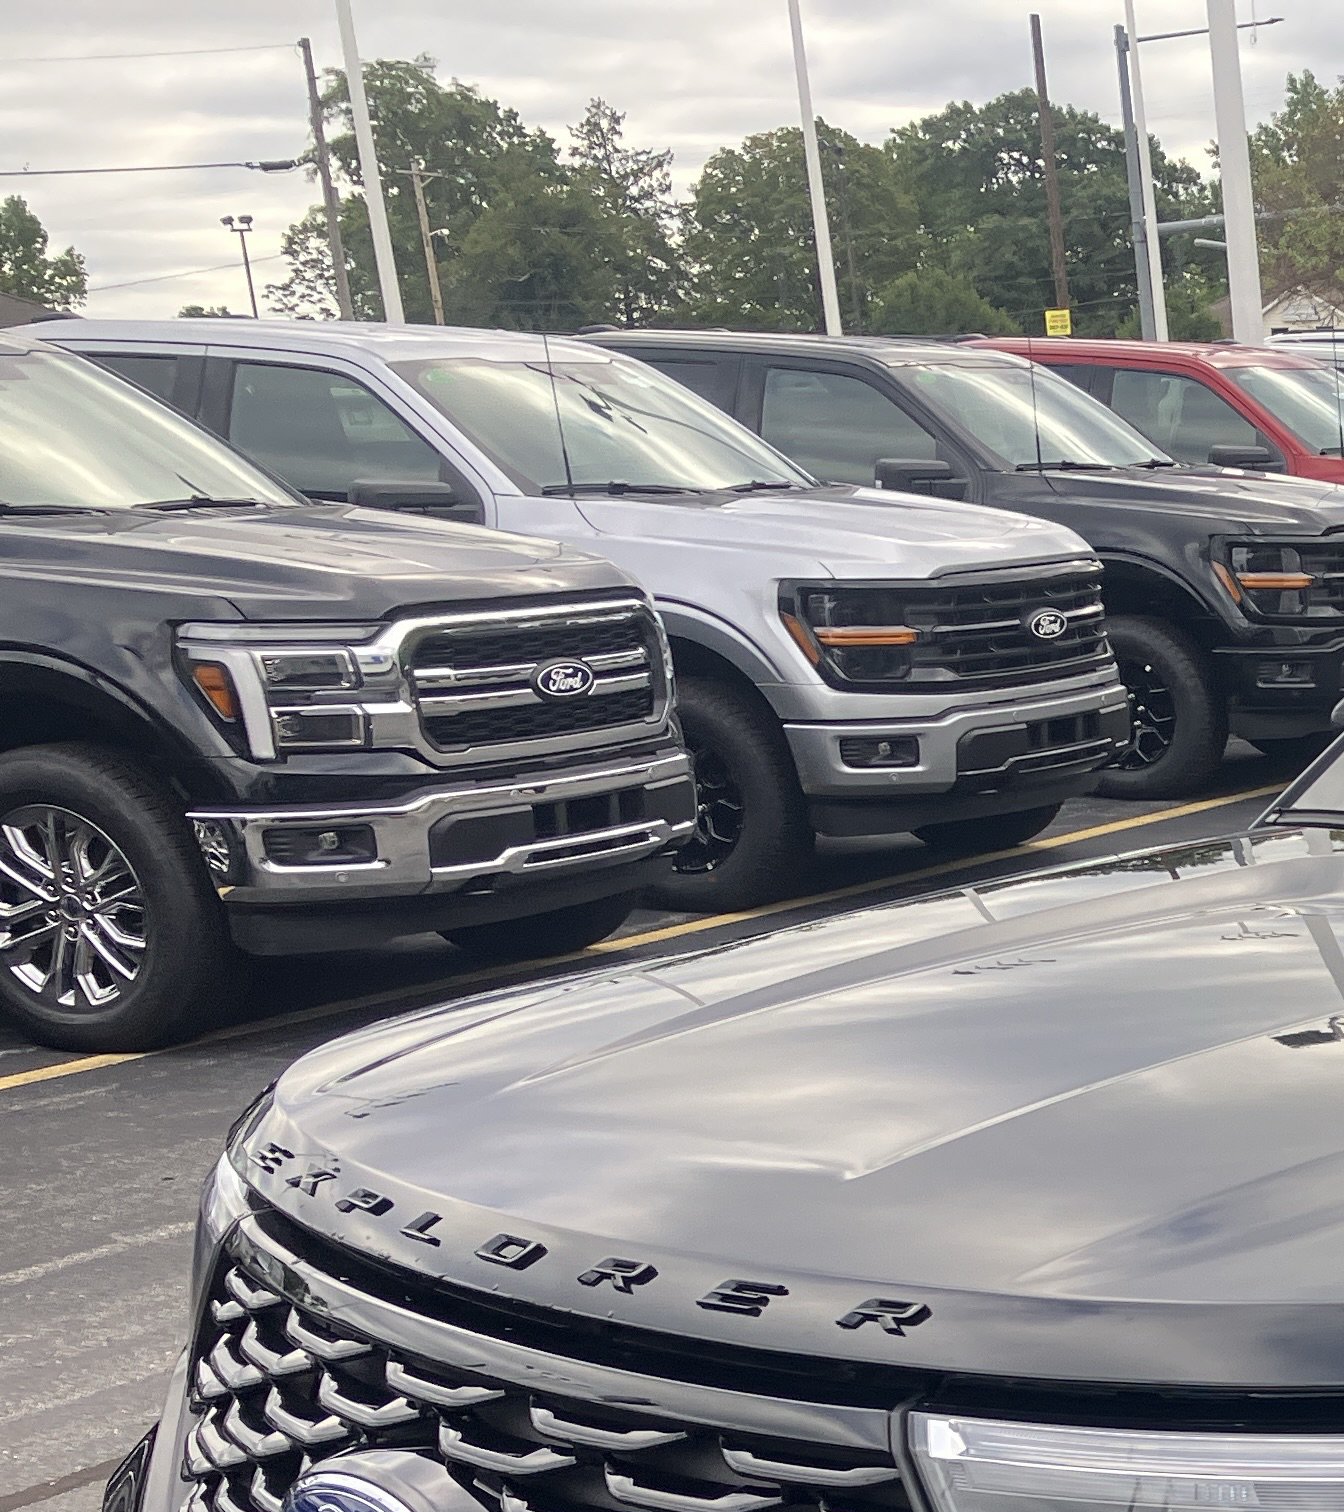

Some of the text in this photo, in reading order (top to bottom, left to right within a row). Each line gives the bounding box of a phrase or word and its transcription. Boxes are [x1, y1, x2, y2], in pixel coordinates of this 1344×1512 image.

[1038, 616, 1061, 635] Ford
[548, 667, 583, 691] Ford
[254, 1142, 933, 1337] EXPLORER
